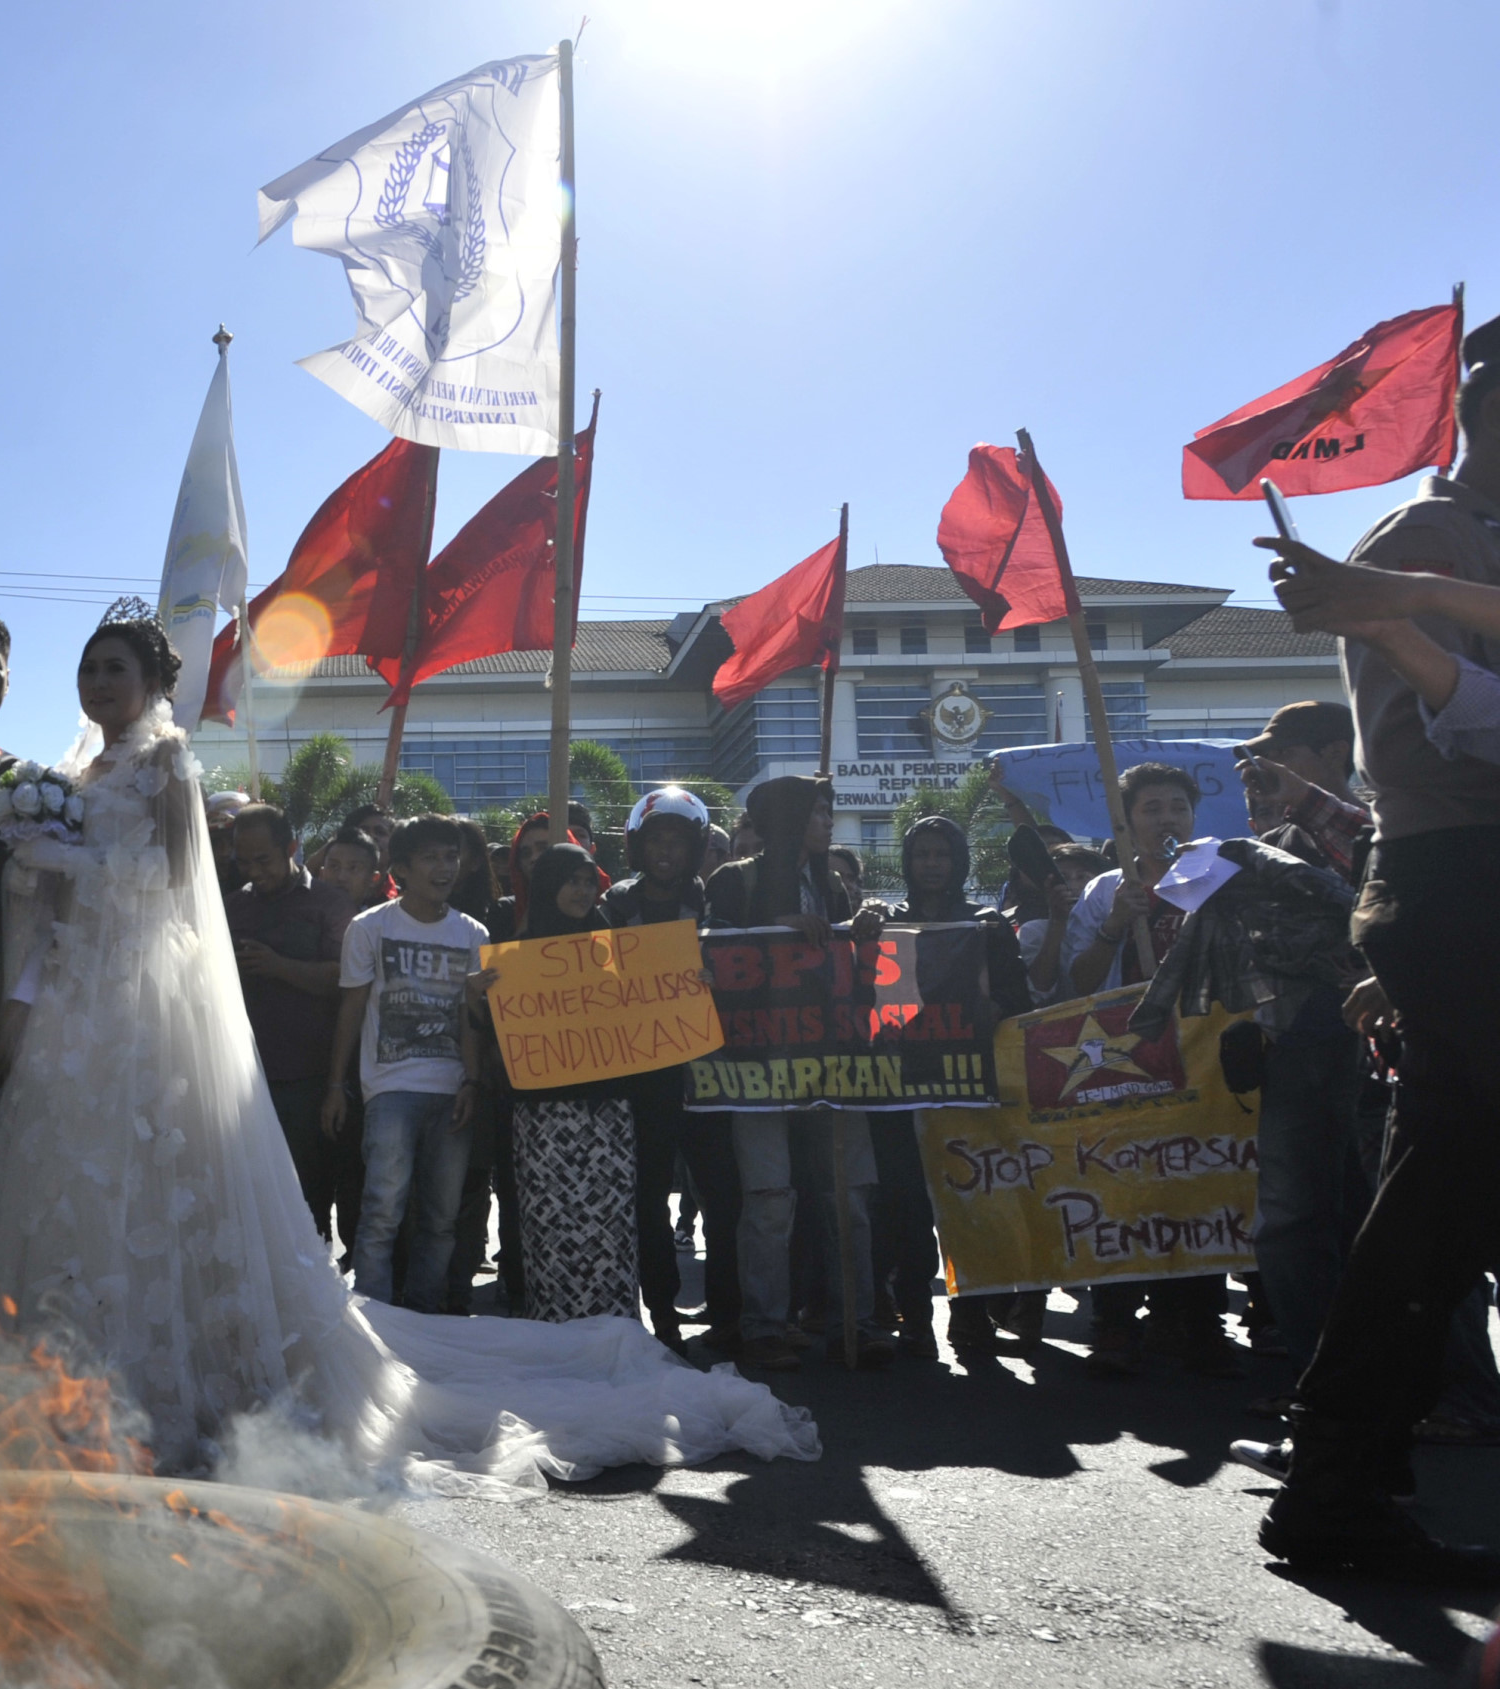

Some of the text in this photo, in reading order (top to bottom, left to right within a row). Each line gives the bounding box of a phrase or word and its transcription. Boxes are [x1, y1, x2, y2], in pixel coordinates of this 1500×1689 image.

[837, 763, 895, 777] BADAN
[879, 777, 959, 790] REPUBLIK
[836, 793, 907, 806] ERWAKILAN
[539, 931, 640, 979] STOP
[708, 940, 902, 996] BPJS
[504, 1003, 713, 1082] PENDIDIKAN
[722, 1002, 975, 1047] ISNIS SOSIAL
[944, 1138, 1053, 1194] STOP
